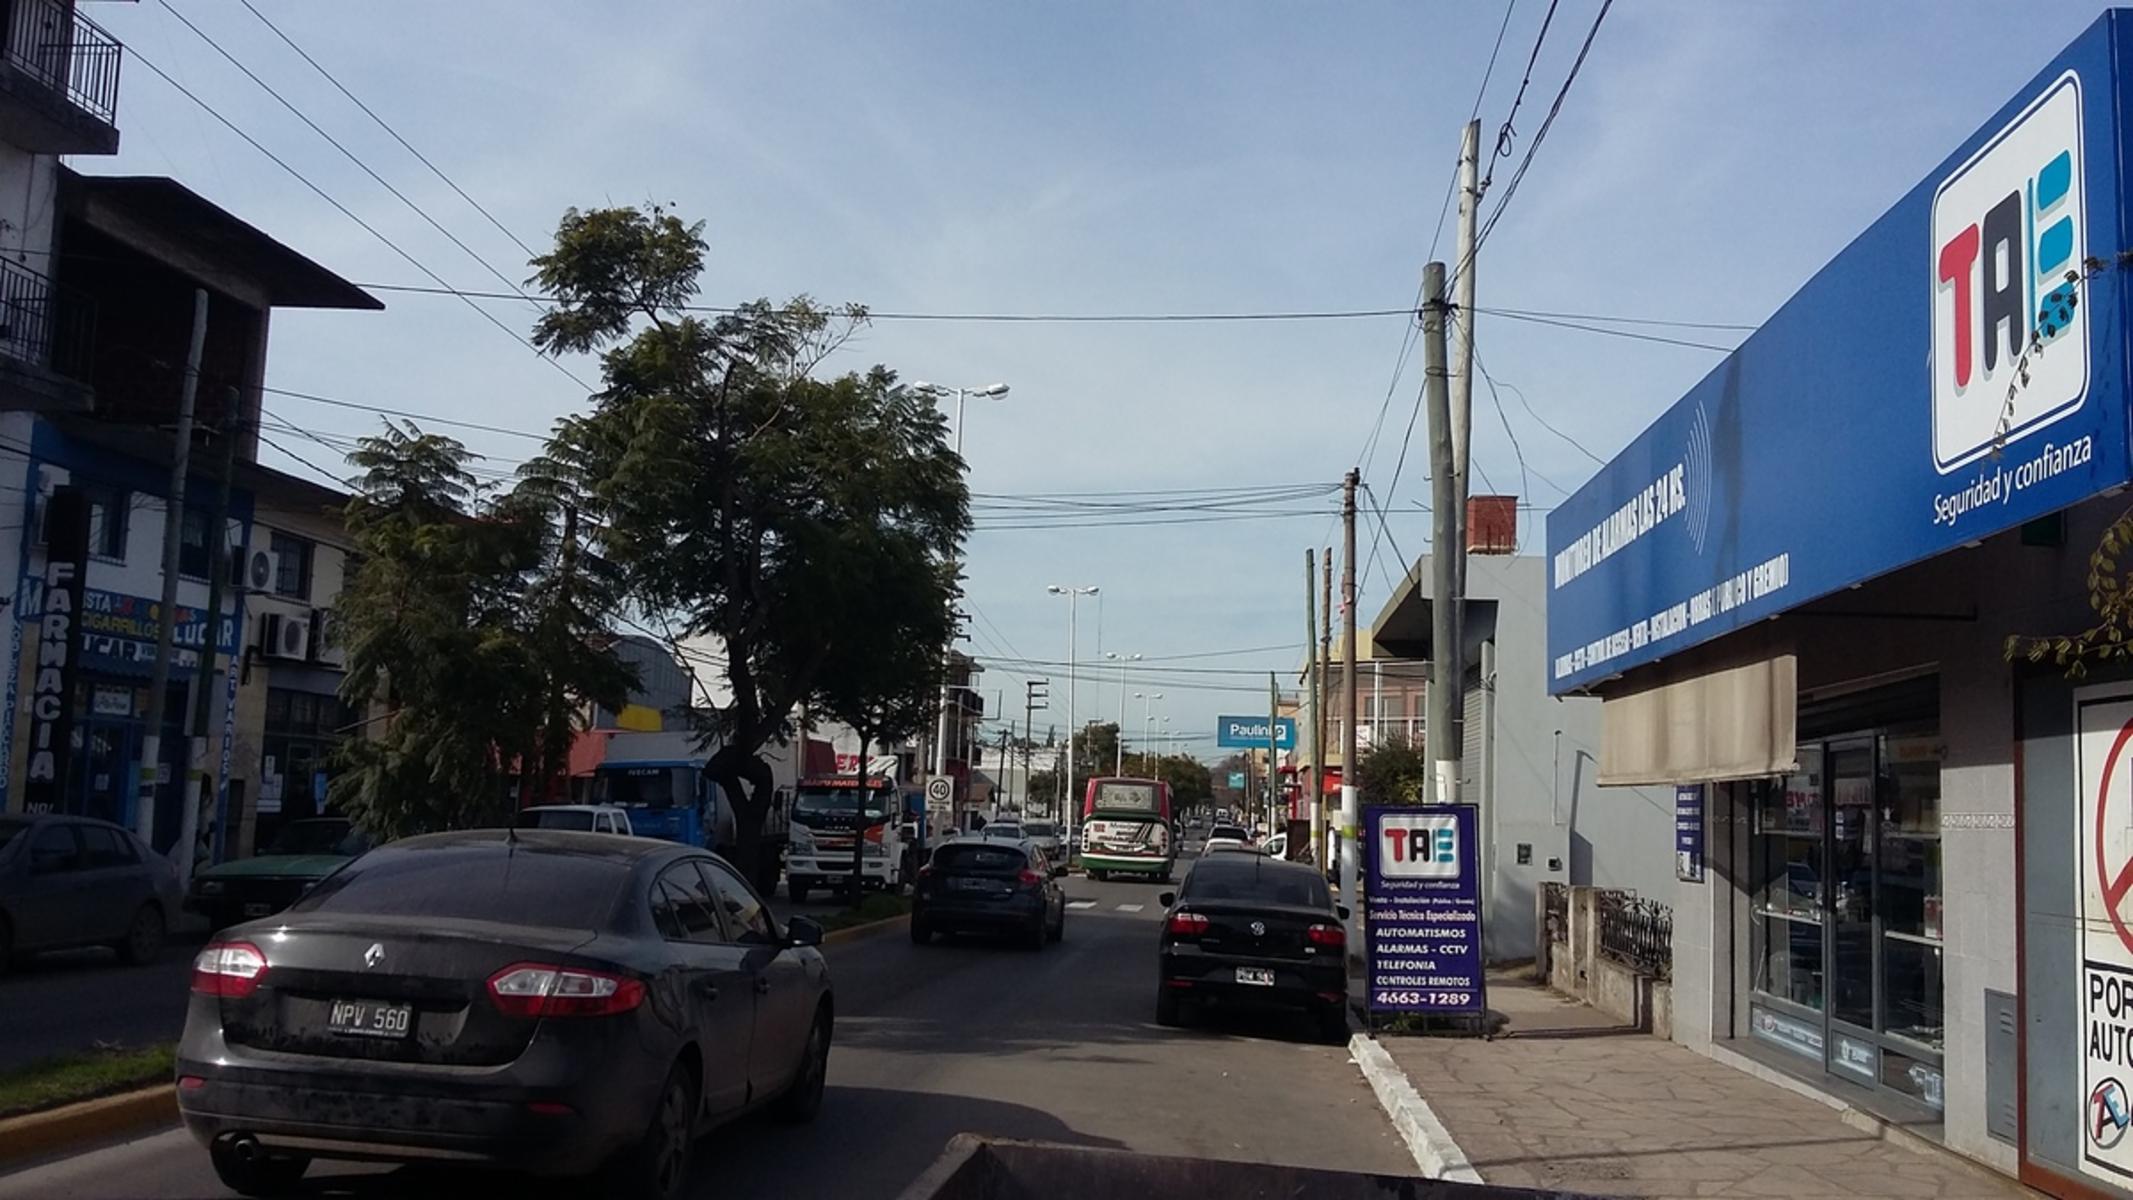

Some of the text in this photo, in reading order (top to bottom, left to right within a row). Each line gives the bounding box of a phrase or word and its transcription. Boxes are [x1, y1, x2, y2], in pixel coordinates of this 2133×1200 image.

[1939, 149, 2079, 388] TAE
[1933, 435, 2091, 527] Seguridad y confianza
[1638, 485, 1655, 535] LAS
[1656, 475, 1668, 523] 24
[29, 561, 76, 781] FARMACIA
[933, 784, 946, 795] 40
[1384, 828, 1454, 862] TAE
[1381, 880, 1460, 890] Seguridad y confianza
[1369, 910, 1397, 920] Servicio
[1426, 910, 1476, 924] Especializado
[1376, 928, 1466, 938] AUTOMATISMOS
[1376, 944, 1468, 954] ALARMAS CCTV
[1376, 960, 1436, 970] TELEFONIA
[1376, 976, 1470, 986] CONTROLES REMOTOS
[1376, 992, 1470, 1006] 4663-1289
[330, 1004, 408, 1031] NPV 560
